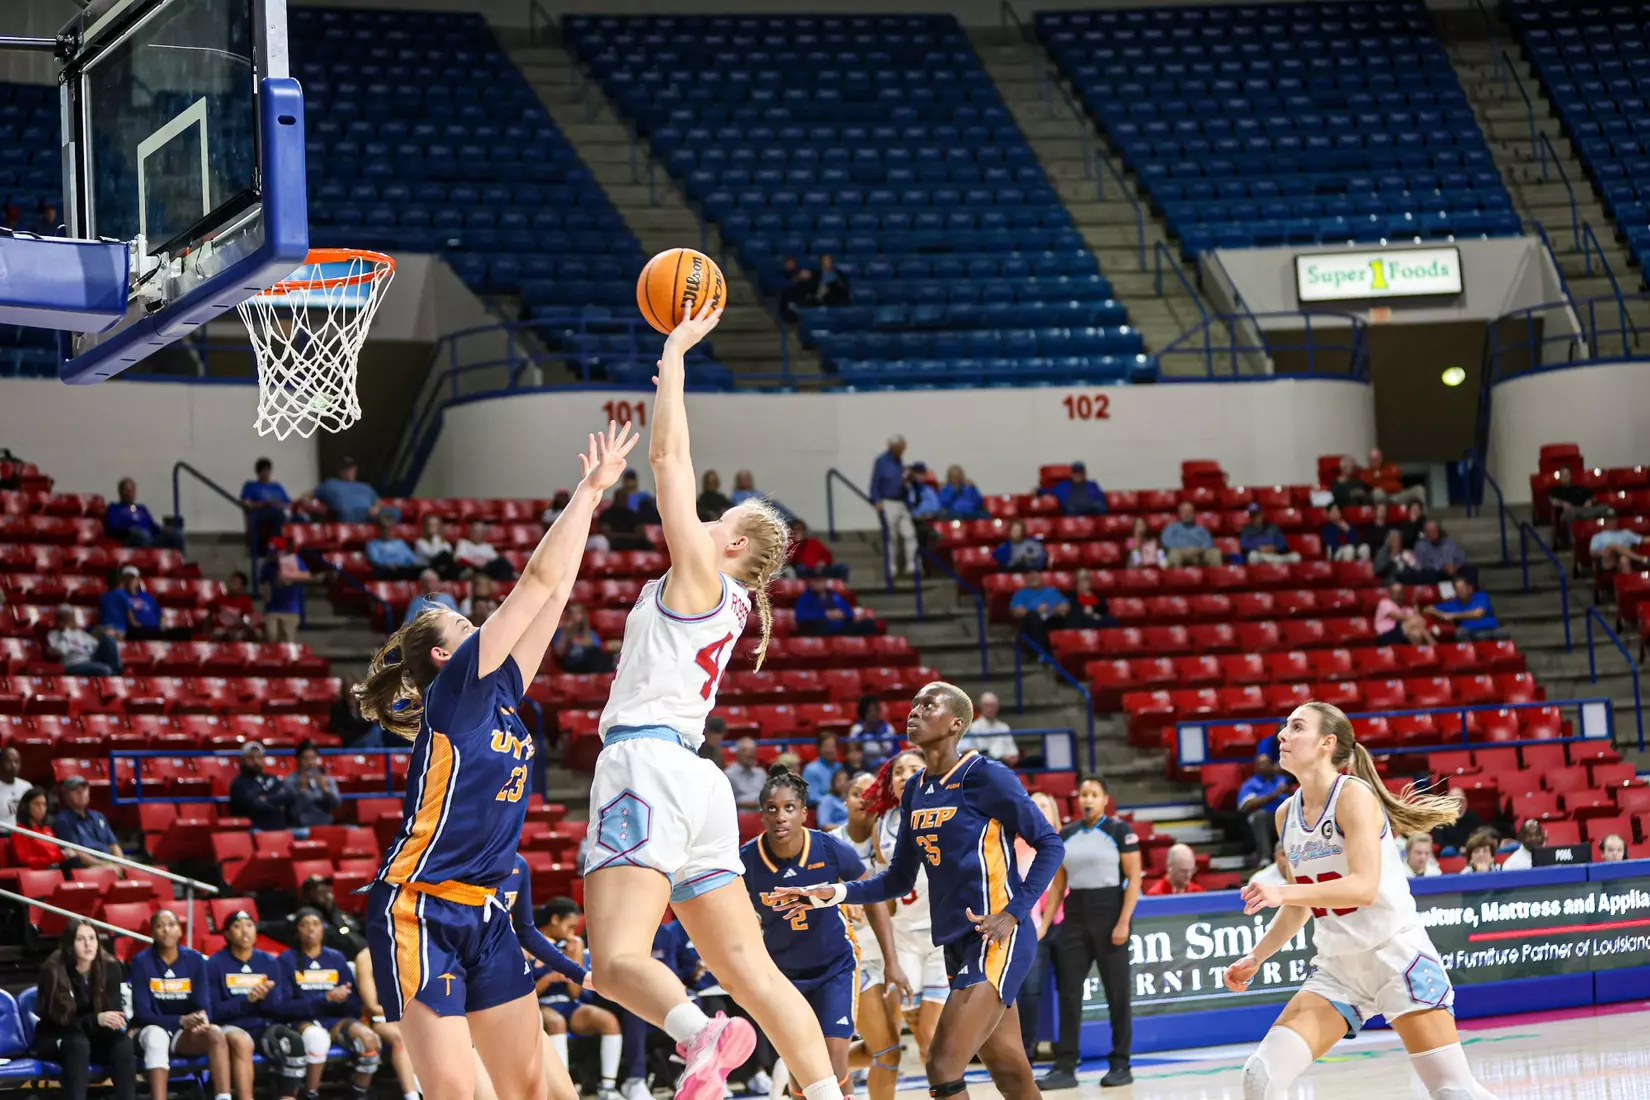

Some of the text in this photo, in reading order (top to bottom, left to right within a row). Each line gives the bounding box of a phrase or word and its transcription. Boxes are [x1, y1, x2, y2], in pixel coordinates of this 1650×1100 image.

[680, 256, 702, 309] Wilson
[1308, 258, 1450, 290] Super 1 Foods
[602, 400, 646, 428] 101
[1062, 393, 1111, 420] 102
[694, 631, 734, 701] 4
[495, 764, 527, 802] 23
[910, 806, 958, 830] TEP
[916, 834, 941, 866] 35
[790, 909, 809, 931] 2
[1481, 899, 1561, 922] Mattress
[1563, 892, 1595, 915] and
[1128, 931, 1174, 965] an
[1456, 946, 1520, 969] Furniture
[1522, 942, 1574, 963] Partner
[1575, 938, 1590, 957] of
[1082, 958, 1308, 1001] FRNITRE
